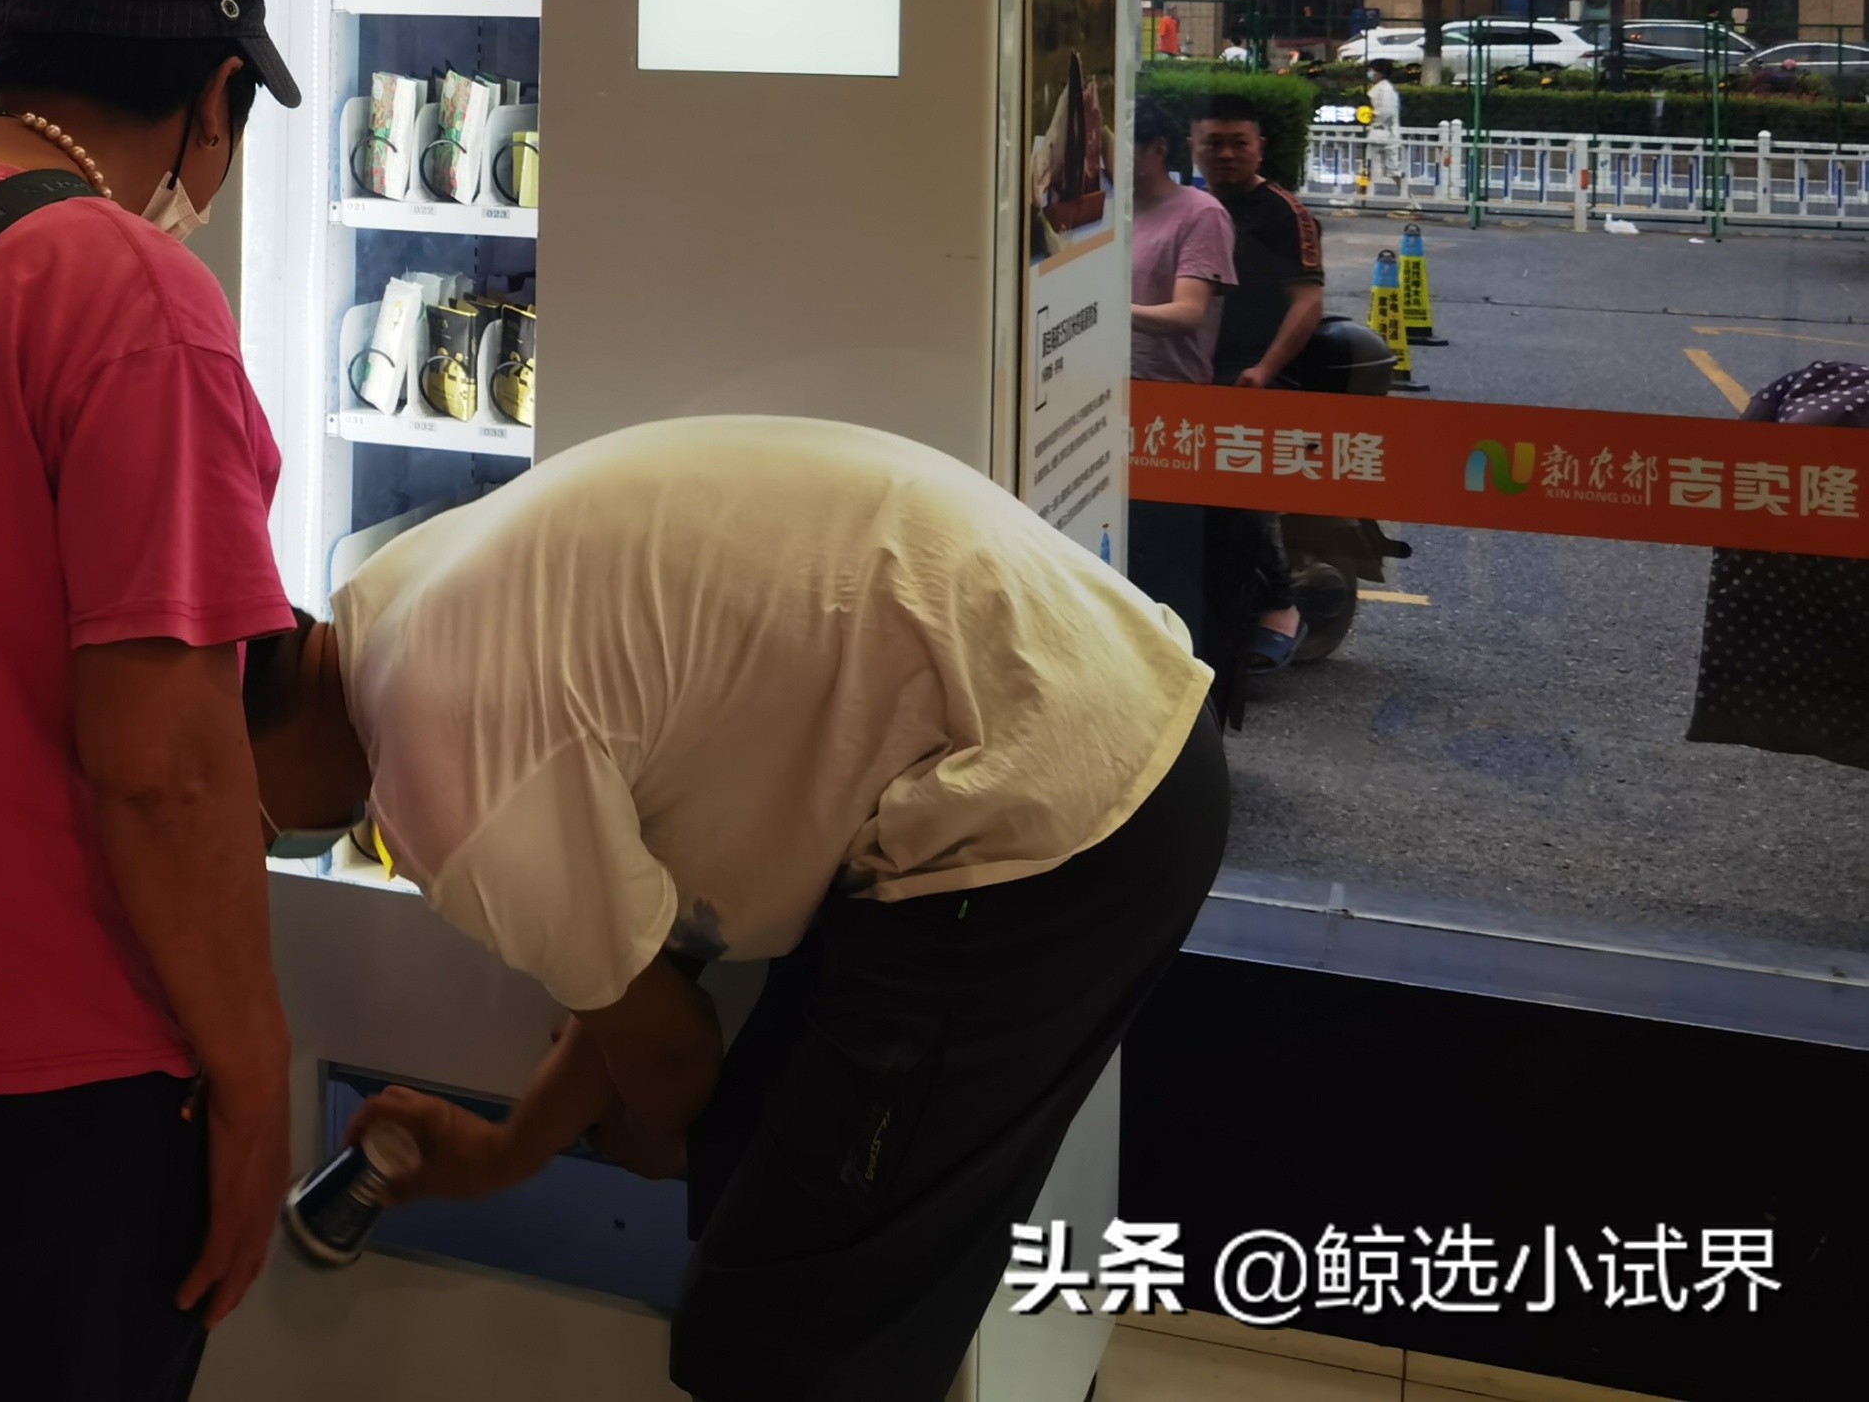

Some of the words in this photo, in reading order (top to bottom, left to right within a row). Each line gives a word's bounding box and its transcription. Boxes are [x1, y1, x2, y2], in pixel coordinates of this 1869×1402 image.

[413, 206, 435, 215] 022
[486, 209, 508, 219] 023
[1172, 458, 1193, 470] DU
[1541, 444, 1659, 507] 新农都
[1575, 490, 1619, 504] NONG
[1621, 494, 1643, 506] DU
